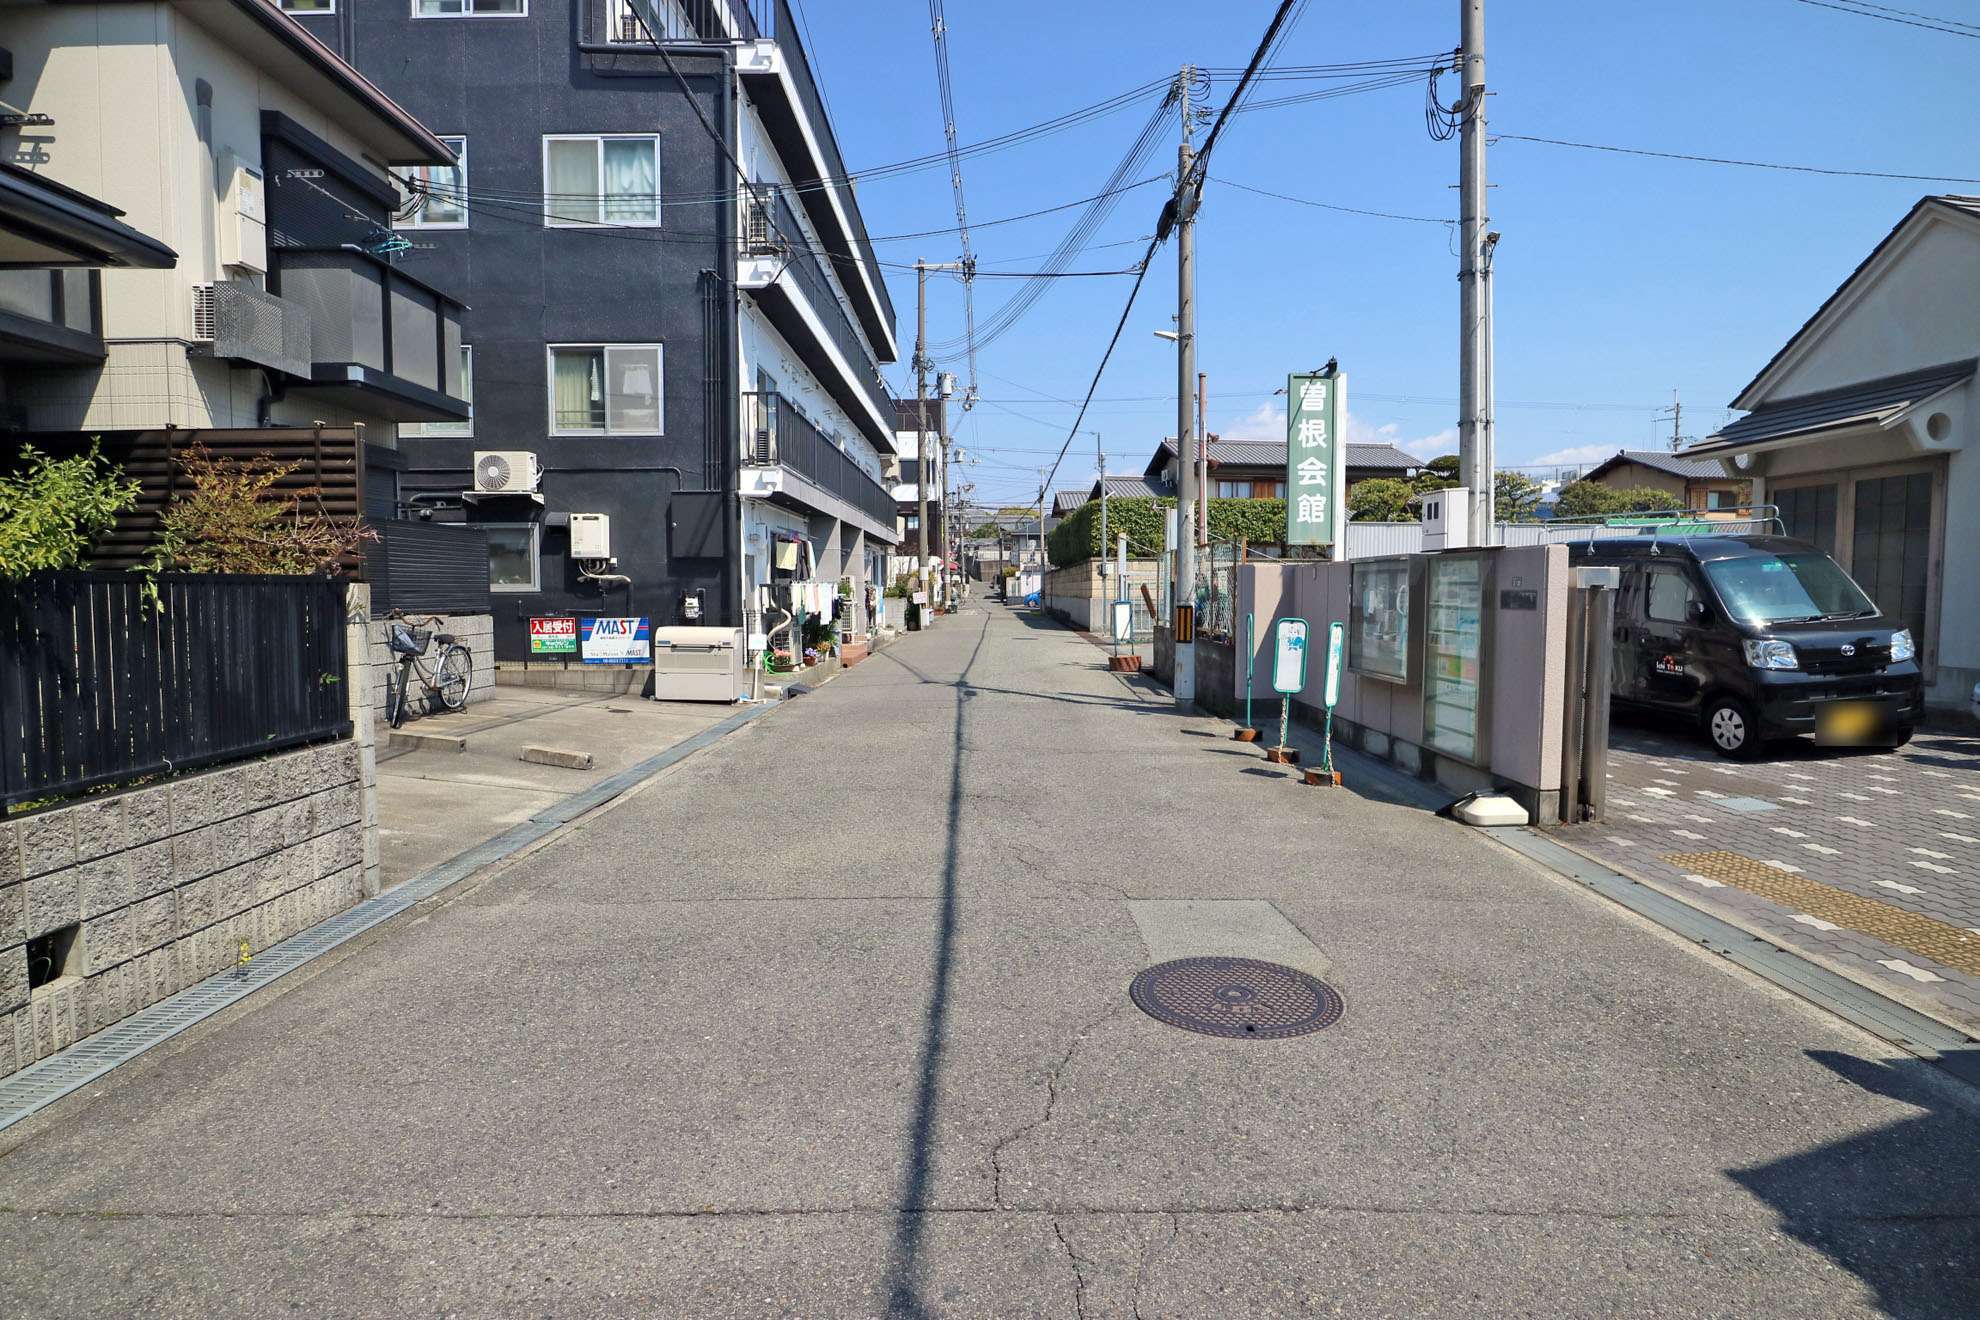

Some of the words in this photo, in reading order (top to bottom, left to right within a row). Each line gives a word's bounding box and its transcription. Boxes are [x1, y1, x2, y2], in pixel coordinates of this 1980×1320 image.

[1296, 381, 1327, 524] 曽根会館
[532, 620, 573, 633] 入居受付
[596, 620, 634, 635] MAST
